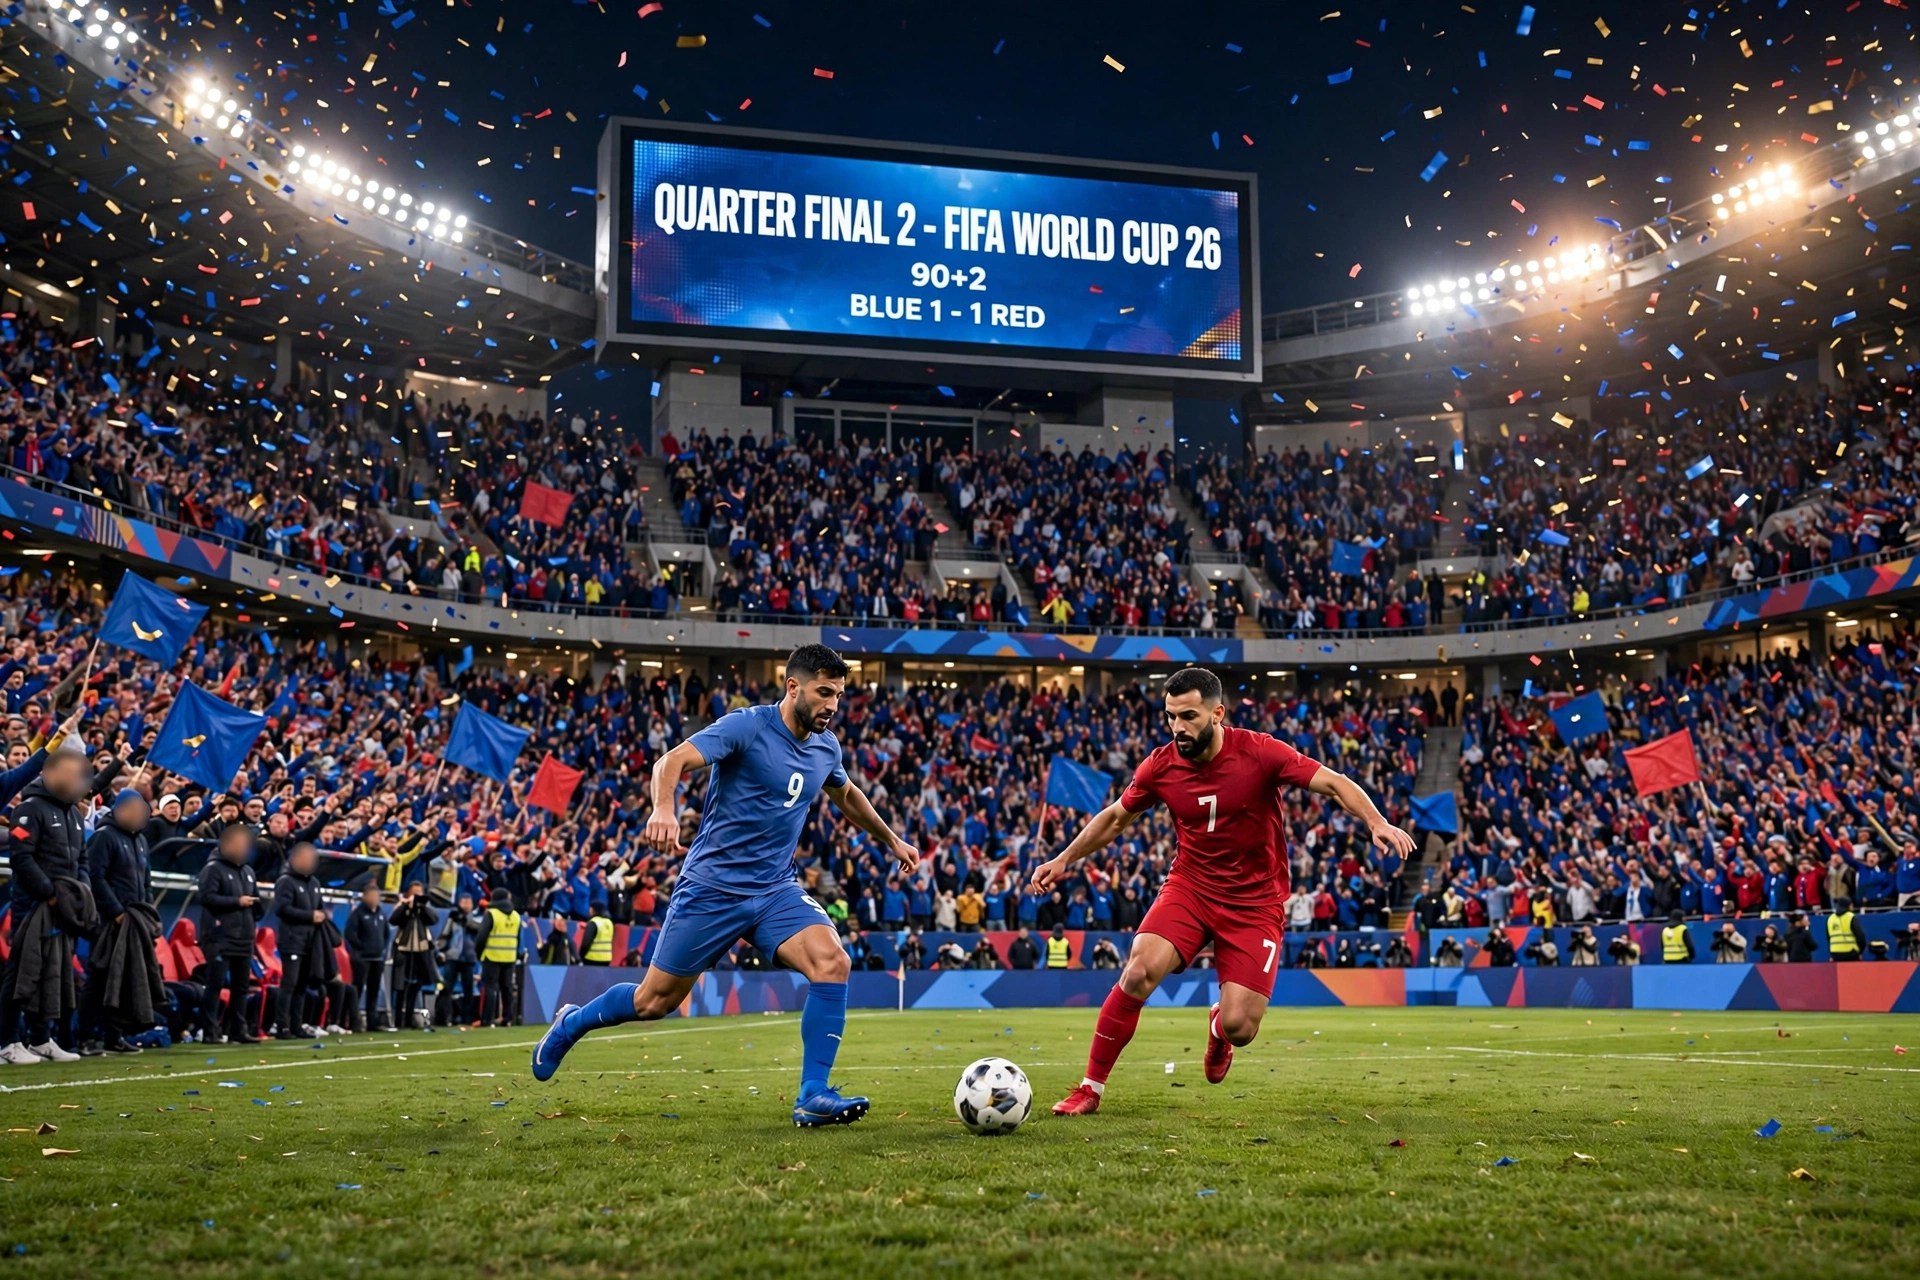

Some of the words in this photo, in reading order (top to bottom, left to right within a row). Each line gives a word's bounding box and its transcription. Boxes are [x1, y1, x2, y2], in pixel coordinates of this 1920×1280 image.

[654, 182, 797, 238] QUARTER
[804, 194, 890, 247] FINAL
[897, 202, 916, 247] 2
[923, 224, 937, 234] -
[944, 206, 1006, 255] FIFA
[1011, 211, 1116, 263] WORLD
[1122, 220, 1179, 267] CUP
[1185, 226, 1222, 271] 26
[911, 262, 987, 291] 90+2
[850, 293, 922, 321] BLUE
[930, 300, 941, 322] 1
[970, 302, 981, 324] 1
[991, 303, 1046, 329] RED
[783, 772, 804, 808] 9
[1198, 795, 1217, 832] 7
[801, 895, 827, 915] 9
[1262, 938, 1277, 974] 7
